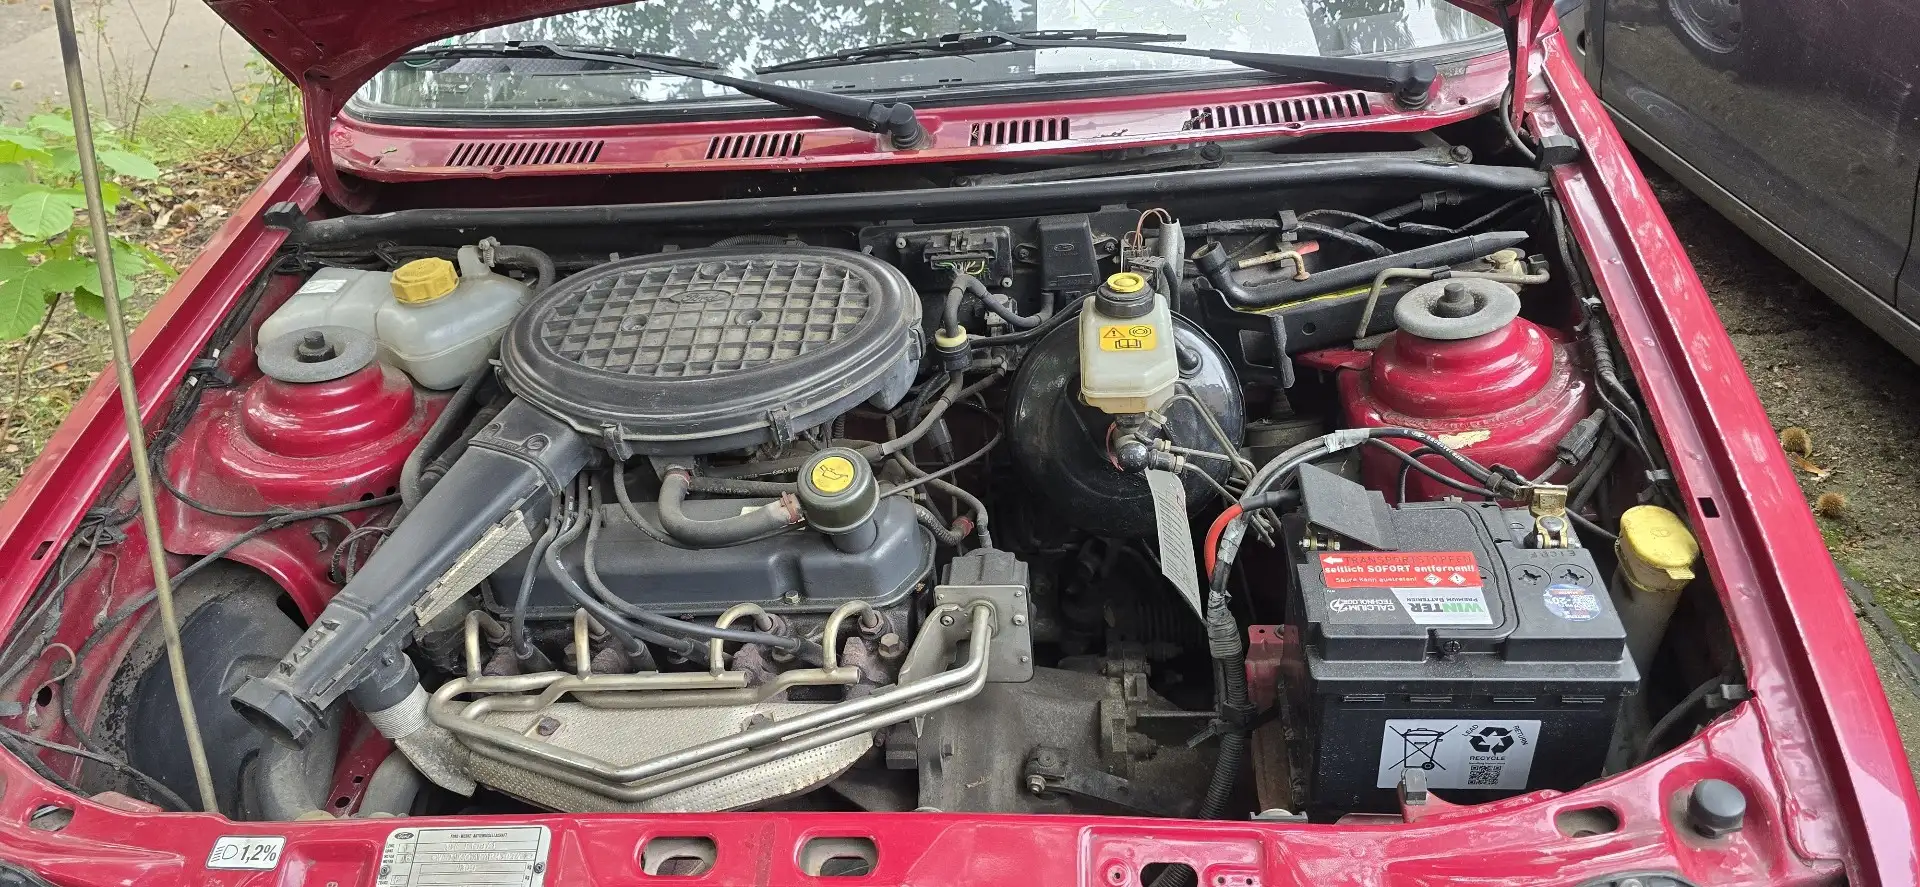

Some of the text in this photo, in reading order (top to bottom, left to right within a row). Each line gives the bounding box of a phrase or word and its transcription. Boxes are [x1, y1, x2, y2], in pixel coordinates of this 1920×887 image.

[1324, 565, 1364, 574] seitlich
[1367, 564, 1411, 573] SOFORT
[1407, 602, 1485, 613] WINTER
[1461, 724, 1479, 737] LEAD
[1512, 724, 1529, 746] RETURN
[239, 844, 277, 864] 1,2%
